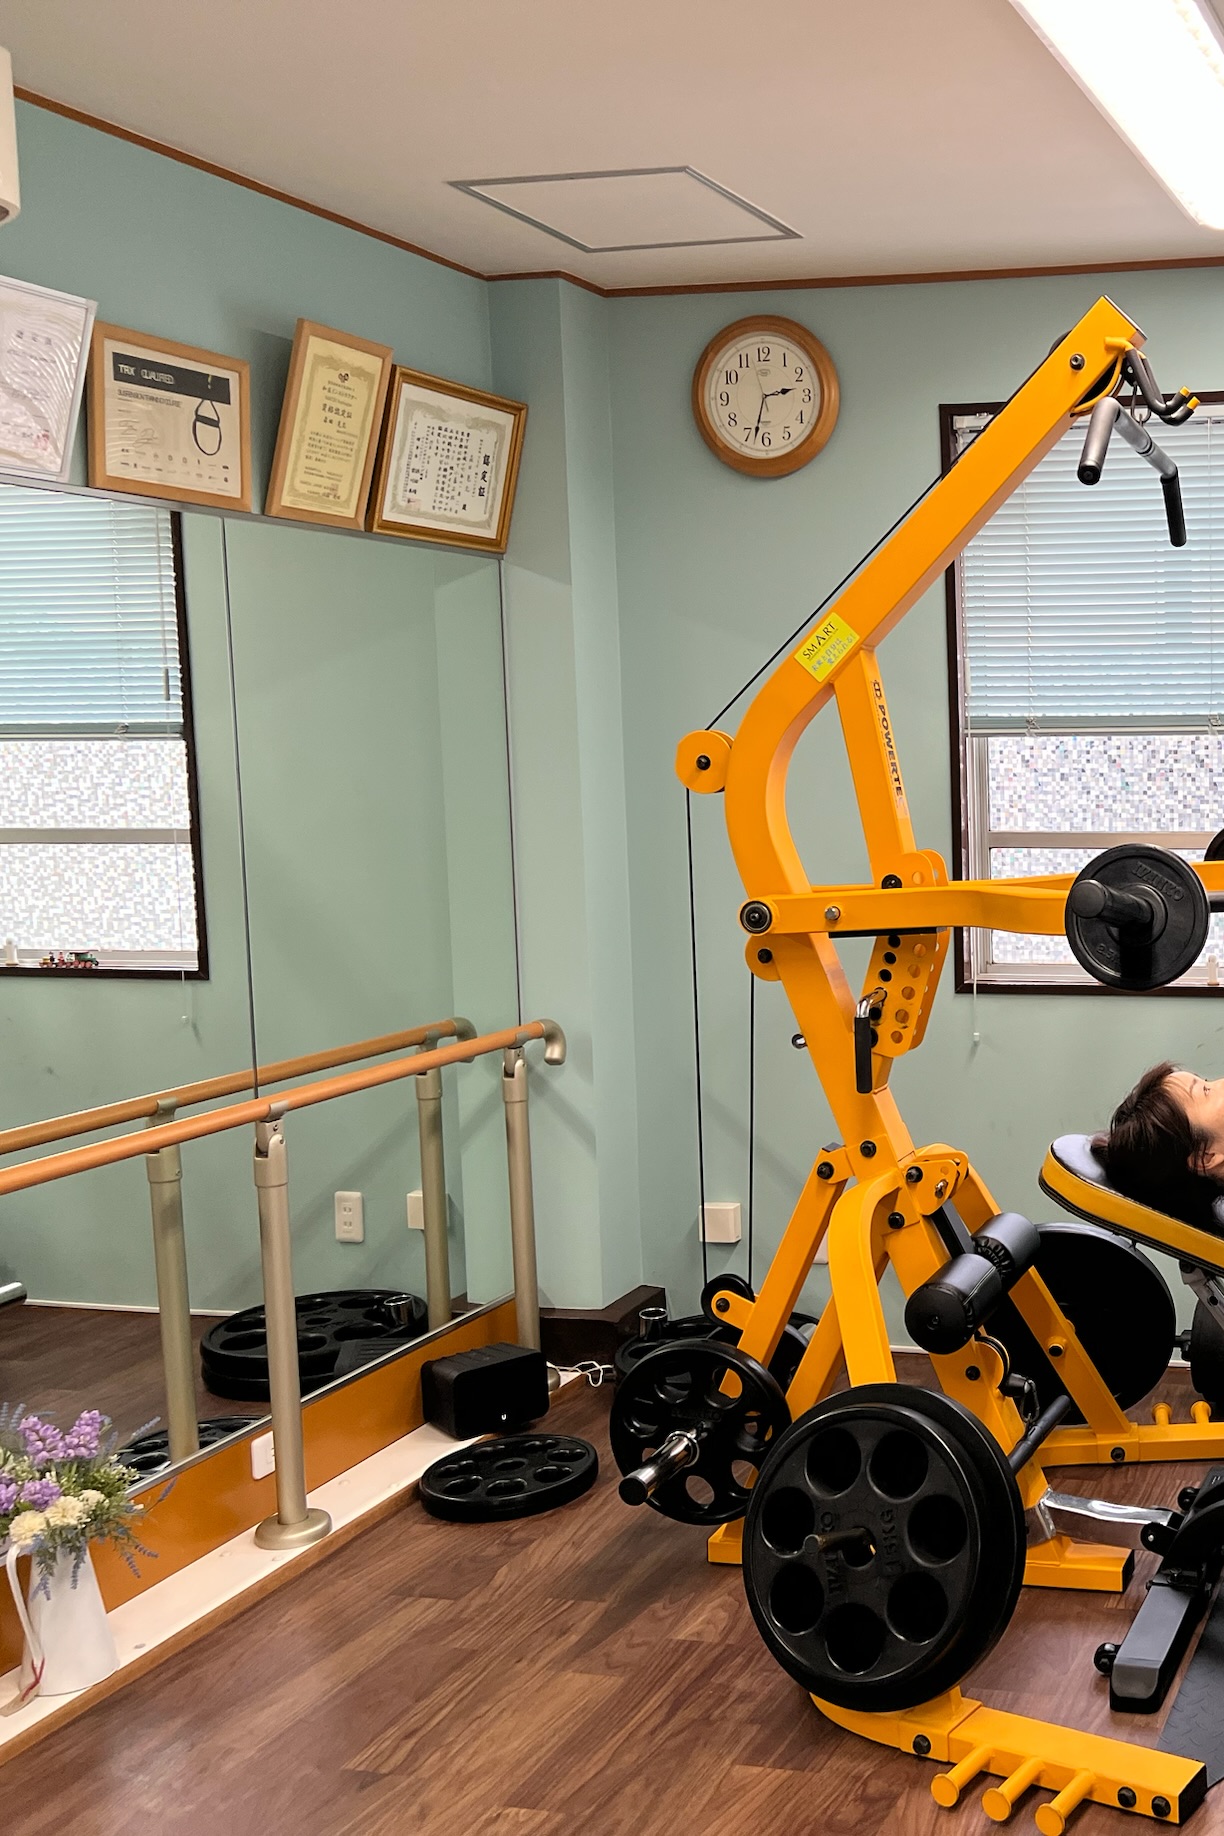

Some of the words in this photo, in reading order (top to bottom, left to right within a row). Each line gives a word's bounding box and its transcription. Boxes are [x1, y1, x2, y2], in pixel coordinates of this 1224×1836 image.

[738, 353, 750, 368] 11
[757, 346, 771, 362] 12
[782, 352, 788, 367] 1
[118, 364, 136, 377] TRX
[725, 369, 739, 385] 10
[794, 367, 804, 382] 2
[720, 391, 730, 406] 9
[802, 388, 811, 403] 3
[727, 412, 738, 427] 8
[795, 409, 804, 424] 4
[743, 427, 752, 442] 7
[761, 432, 772, 447] 6
[782, 426, 791, 440] 5
[802, 621, 836, 660] SMART
